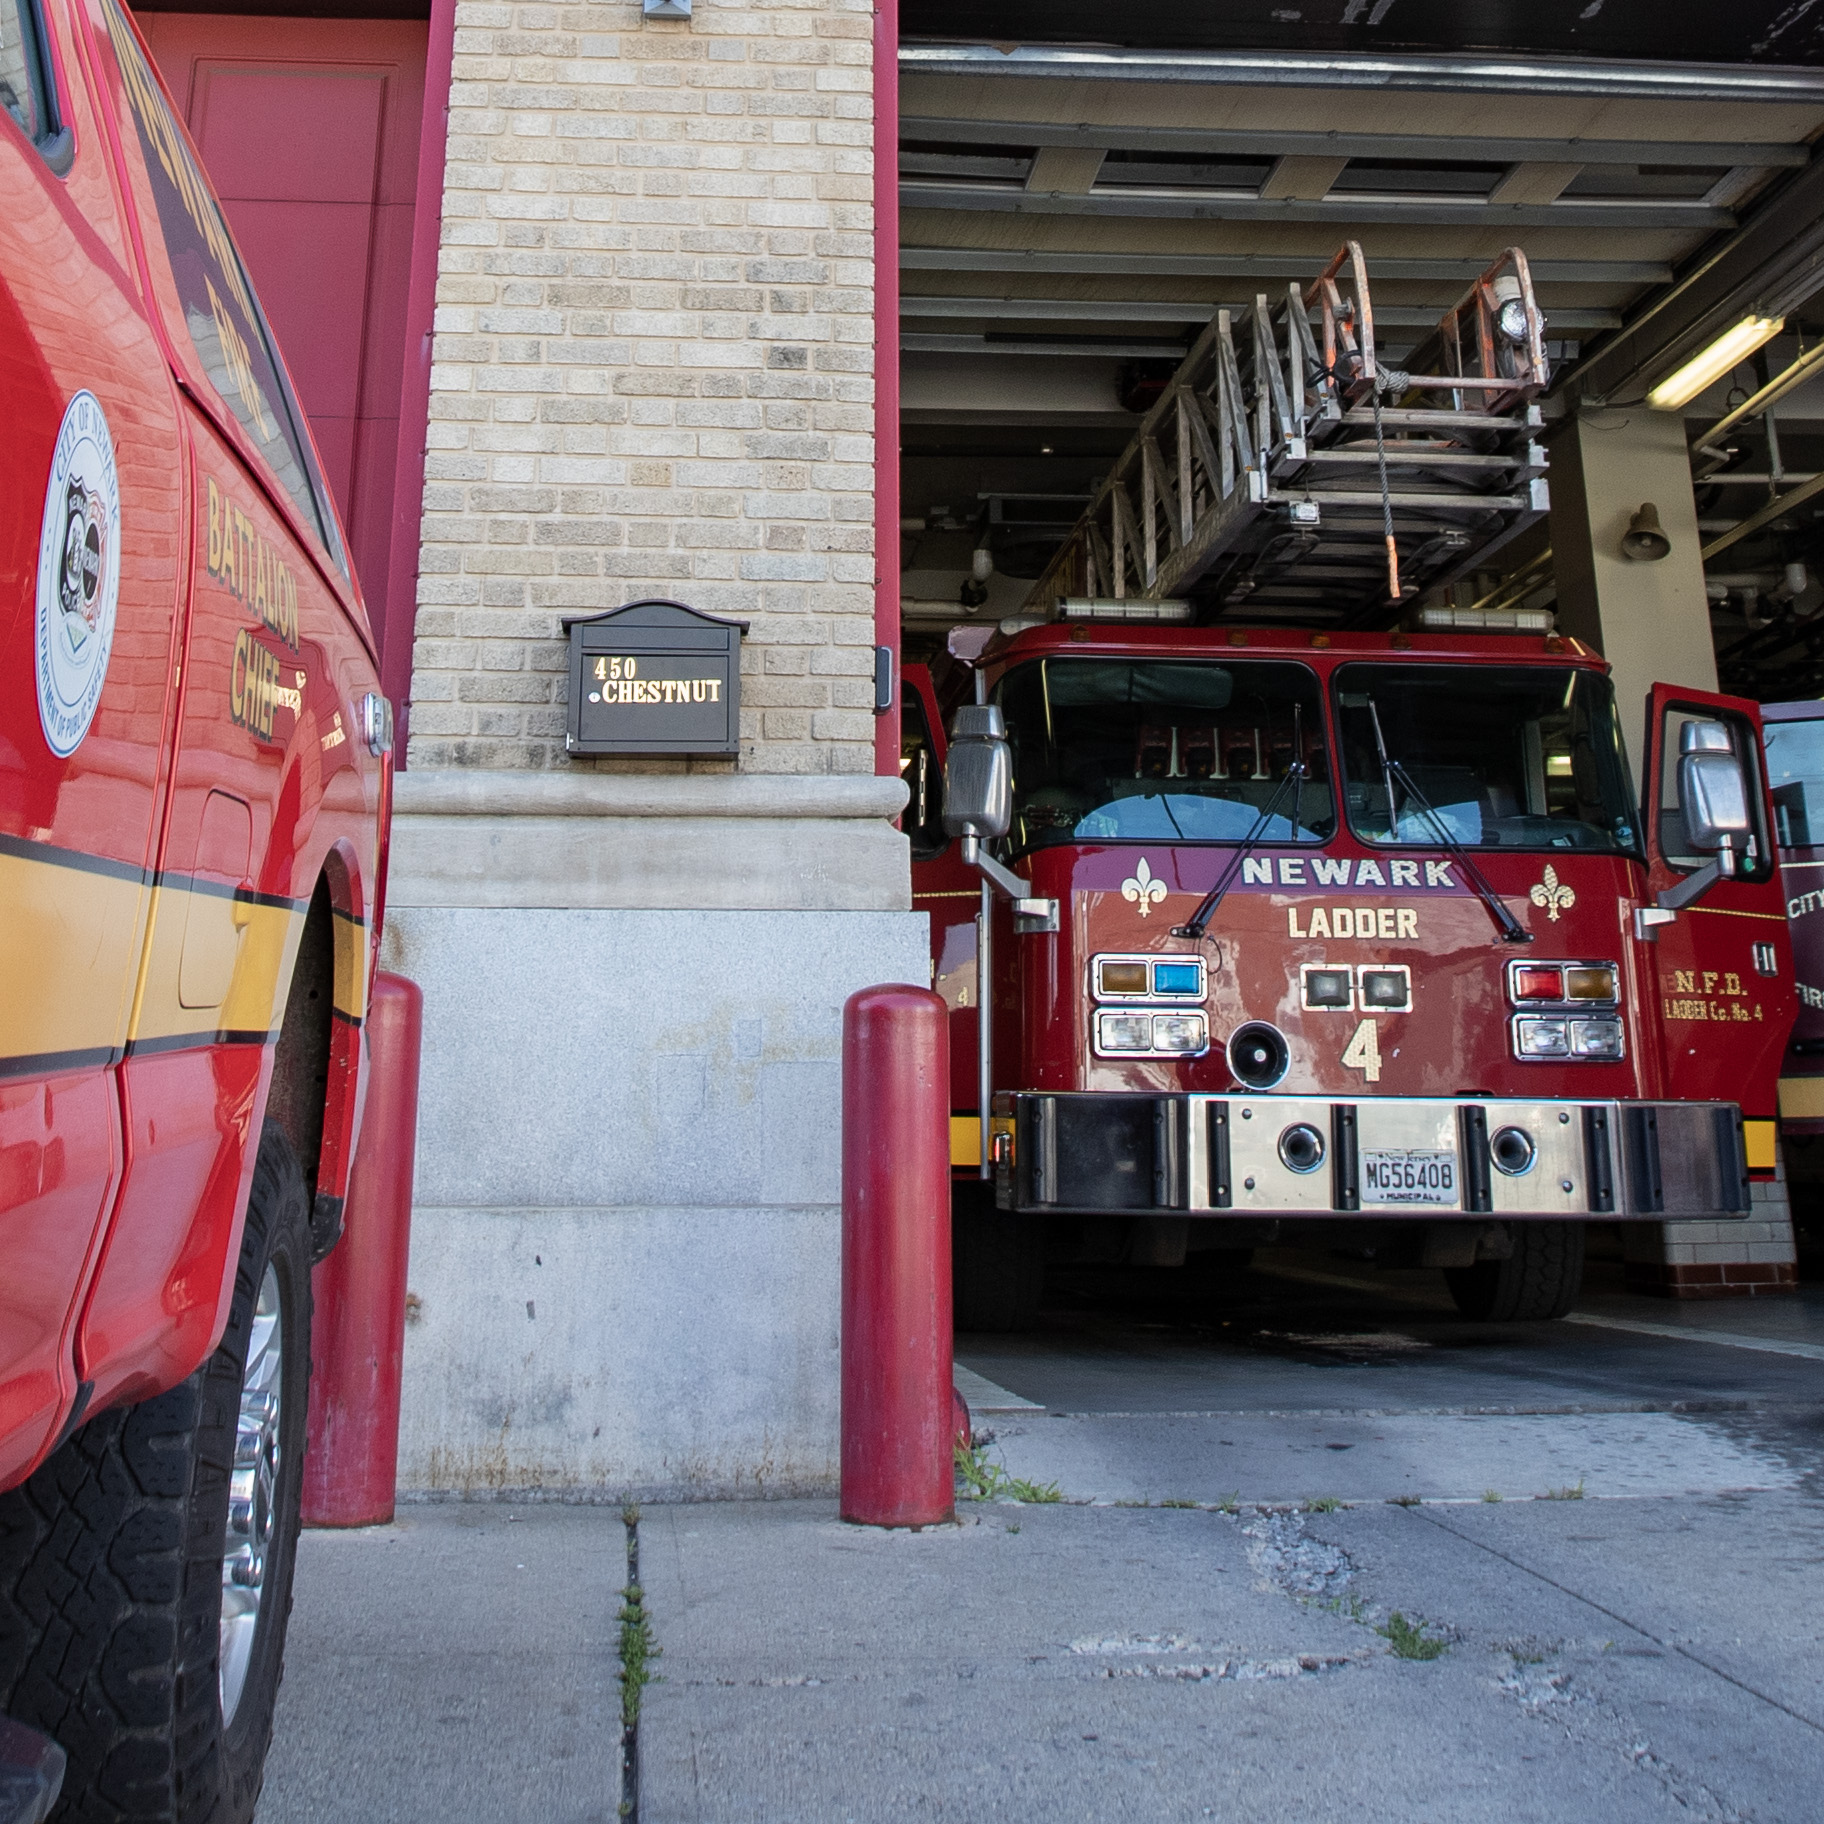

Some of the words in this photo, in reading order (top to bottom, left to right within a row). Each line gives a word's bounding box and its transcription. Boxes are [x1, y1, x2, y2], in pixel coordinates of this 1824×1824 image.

[56, 410, 76, 482] CITY
[78, 403, 90, 431] OF
[207, 475, 299, 656] BATTALION
[594, 657, 636, 680] 450
[230, 627, 280, 743] CHIEF
[601, 679, 722, 703] CHESTNUT
[1242, 857, 1456, 887] NEWARK
[1288, 907, 1419, 939] LADDER
[1674, 969, 1748, 995] N.F.D.
[1664, 998, 1708, 1020] LADDER
[1754, 1003, 1763, 1021] 4
[1341, 1018, 1382, 1083] 4
[1366, 1163, 1452, 1189] MG56408
[1386, 1193, 1434, 1201] MUNICIPAL
